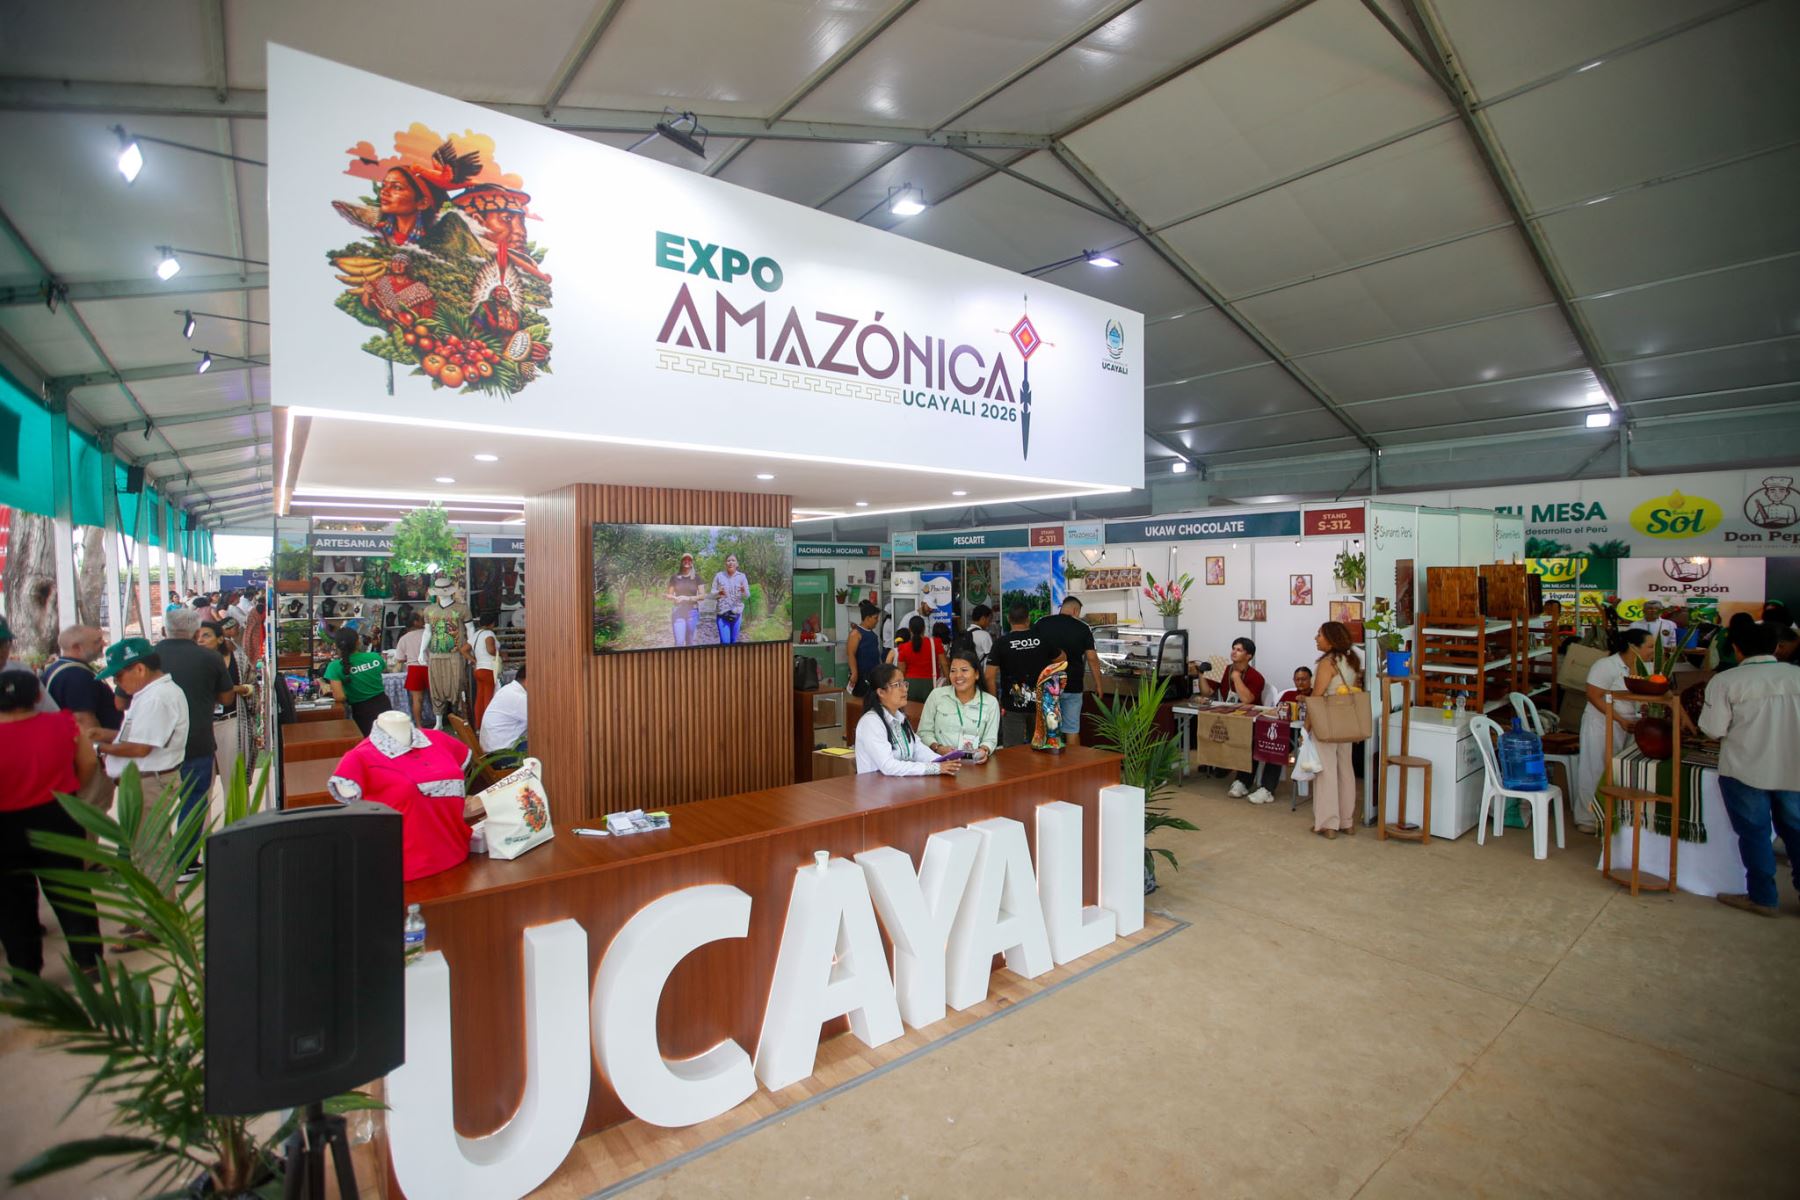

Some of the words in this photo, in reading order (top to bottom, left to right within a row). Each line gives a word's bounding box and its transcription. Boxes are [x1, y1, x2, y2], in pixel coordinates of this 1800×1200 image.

[655, 230, 784, 293] EXPO
[656, 281, 1016, 404] AMAZÓNICA
[1101, 361, 1129, 376] UCAYALI
[902, 389, 977, 417] UCAYALI
[980, 402, 1018, 423] 2026
[1322, 512, 1348, 520] STAND
[1531, 501, 1607, 523] MESA
[1317, 519, 1352, 531] S-312
[1646, 508, 1706, 534] Sol
[1144, 524, 1176, 537] UKAW
[1178, 520, 1245, 535] CHOCOLATE
[316, 538, 377, 548] ARTESANIA
[378, 539, 396, 548] AN
[953, 535, 985, 545] PESCARTE
[1724, 531, 1762, 542] Don
[1769, 530, 1800, 544] Pep
[511, 542, 525, 551] ME
[1648, 583, 1678, 593] Don
[1682, 583, 1730, 595] Pepón
[1625, 605, 1644, 618] So
[1010, 638, 1041, 649] Polo
[350, 659, 380, 675] CIELO
[384, 784, 1146, 1200] UCAYALI
